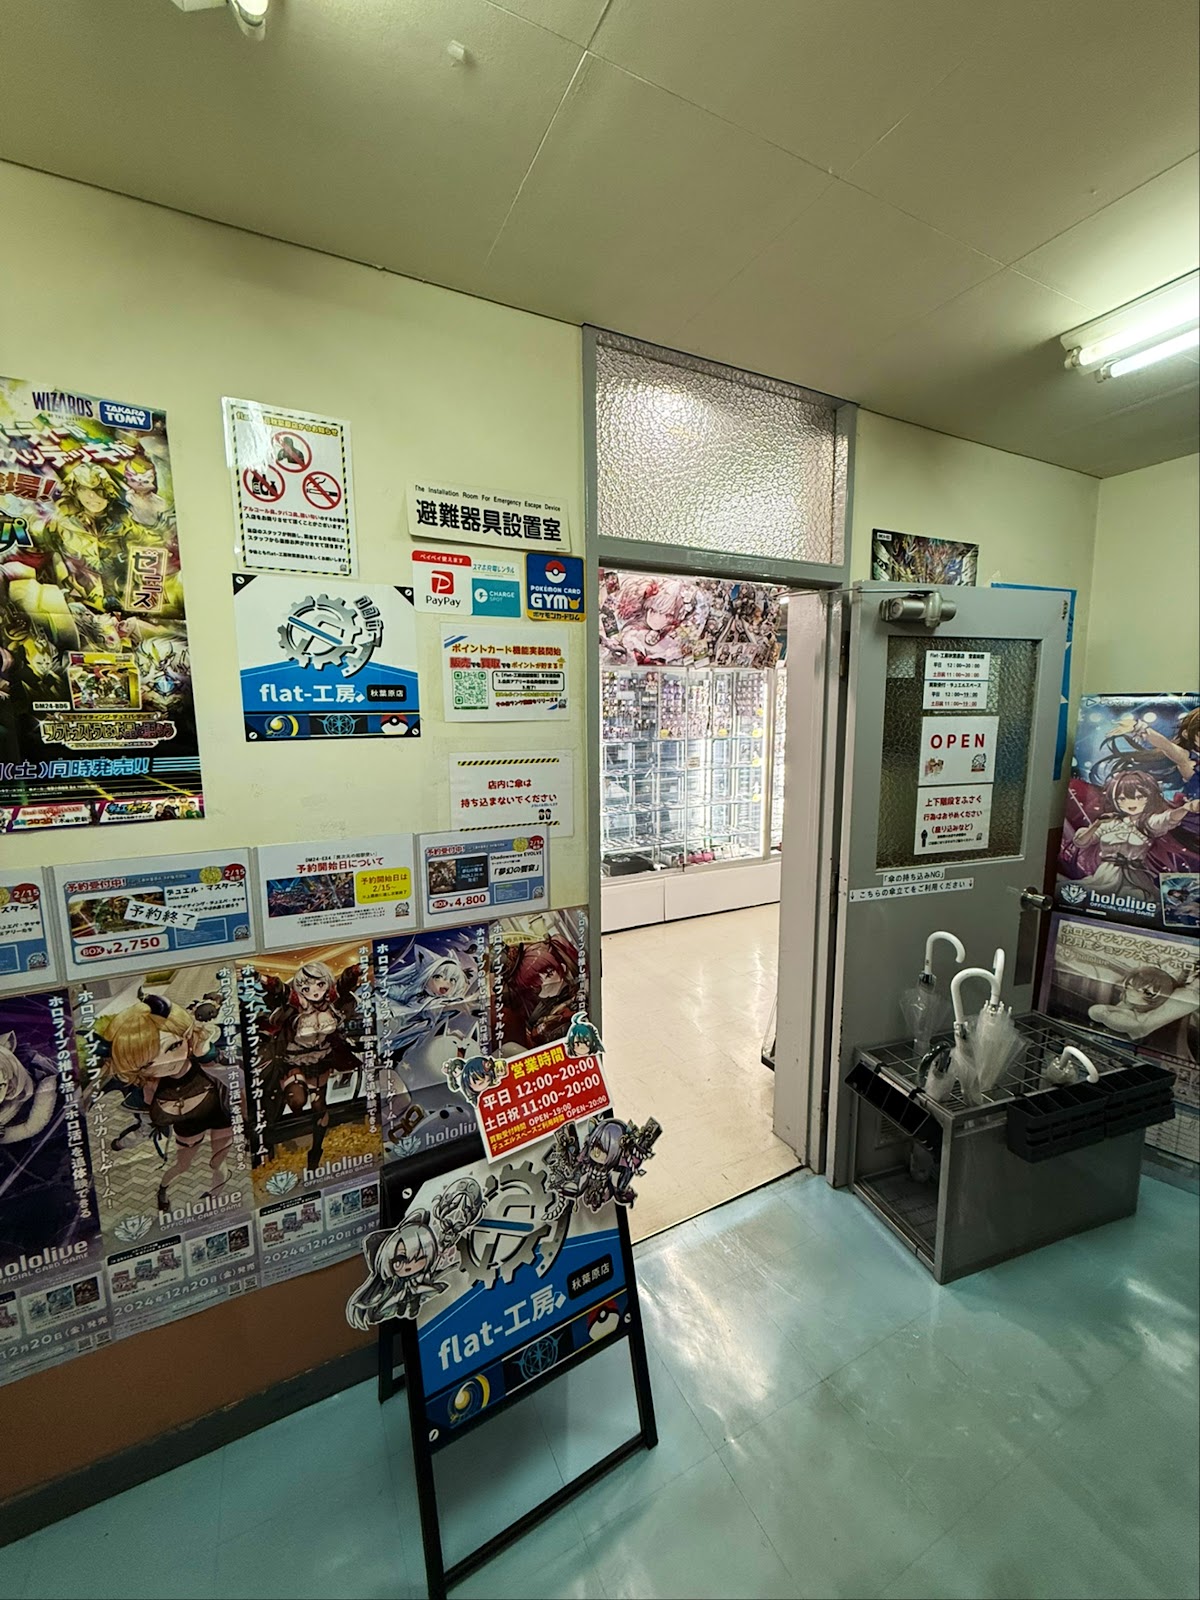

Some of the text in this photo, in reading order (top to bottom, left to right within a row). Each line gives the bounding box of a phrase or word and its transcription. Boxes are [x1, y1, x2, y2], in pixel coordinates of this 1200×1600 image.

[32, 392, 93, 417] WIZARDS
[104, 403, 146, 417] TAKARA
[105, 412, 146, 426] TOMY
[428, 487, 459, 497] Installation
[462, 492, 478, 500] Room
[494, 496, 521, 507] Emergency
[524, 501, 541, 509] Escape
[544, 503, 561, 512] Device
[416, 499, 562, 542] 避難器具設置室
[132, 552, 163, 610] ゼニス
[530, 584, 562, 594] POKÉMON
[425, 595, 461, 608] PayPay
[489, 590, 515, 599] CHARGE
[531, 593, 568, 610] GYM
[533, 611, 580, 621] ポケモンカードジム
[259, 684, 355, 703] flat-工房
[371, 689, 404, 698] 秋葉原店
[930, 733, 986, 749] OPEN
[487, 779, 532, 790] 店内に傘は
[460, 794, 557, 808] 持ち込まないでください
[427, 845, 465, 856] 予約受付中!
[225, 868, 245, 877] 2/15
[296, 857, 384, 874] 予約開始日について
[67, 878, 127, 892] 予約受付中!
[361, 873, 408, 885] 予約開始日は
[884, 871, 944, 883] 「傘の持ち込みNG」
[14, 889, 39, 898] 2/15
[860, 881, 966, 899] こちらの傘立てをご利用ください
[433, 900, 447, 908] BOX
[1090, 890, 1157, 912] hololive
[1090, 901, 1117, 911] OFFICIAL
[1119, 906, 1135, 914] CARD
[1137, 909, 1155, 917] GAME
[128, 903, 197, 927] 予約終了
[82, 937, 160, 957] BOX ¥2,750
[511, 1047, 565, 1080] 営業時間
[483, 1057, 595, 1111] 平日 12:00~20:00
[485, 1108, 521, 1132] 土日祝
[522, 1073, 601, 1117] 11:00~20:00
[425, 1122, 477, 1145] hololiv
[489, 1122, 527, 1144] 買取受付時間
[303, 1152, 373, 1182] hololive
[304, 1162, 373, 1187] OFFICIAL CARD GAME
[159, 1190, 242, 1226] hololive
[160, 1202, 241, 1231] OFFICIAL CARD GAME
[35, 1261, 60, 1274] CARD
[62, 1252, 89, 1266] GAME
[571, 1263, 610, 1291] 秋葉原店
[438, 1284, 553, 1371] flat-工房
